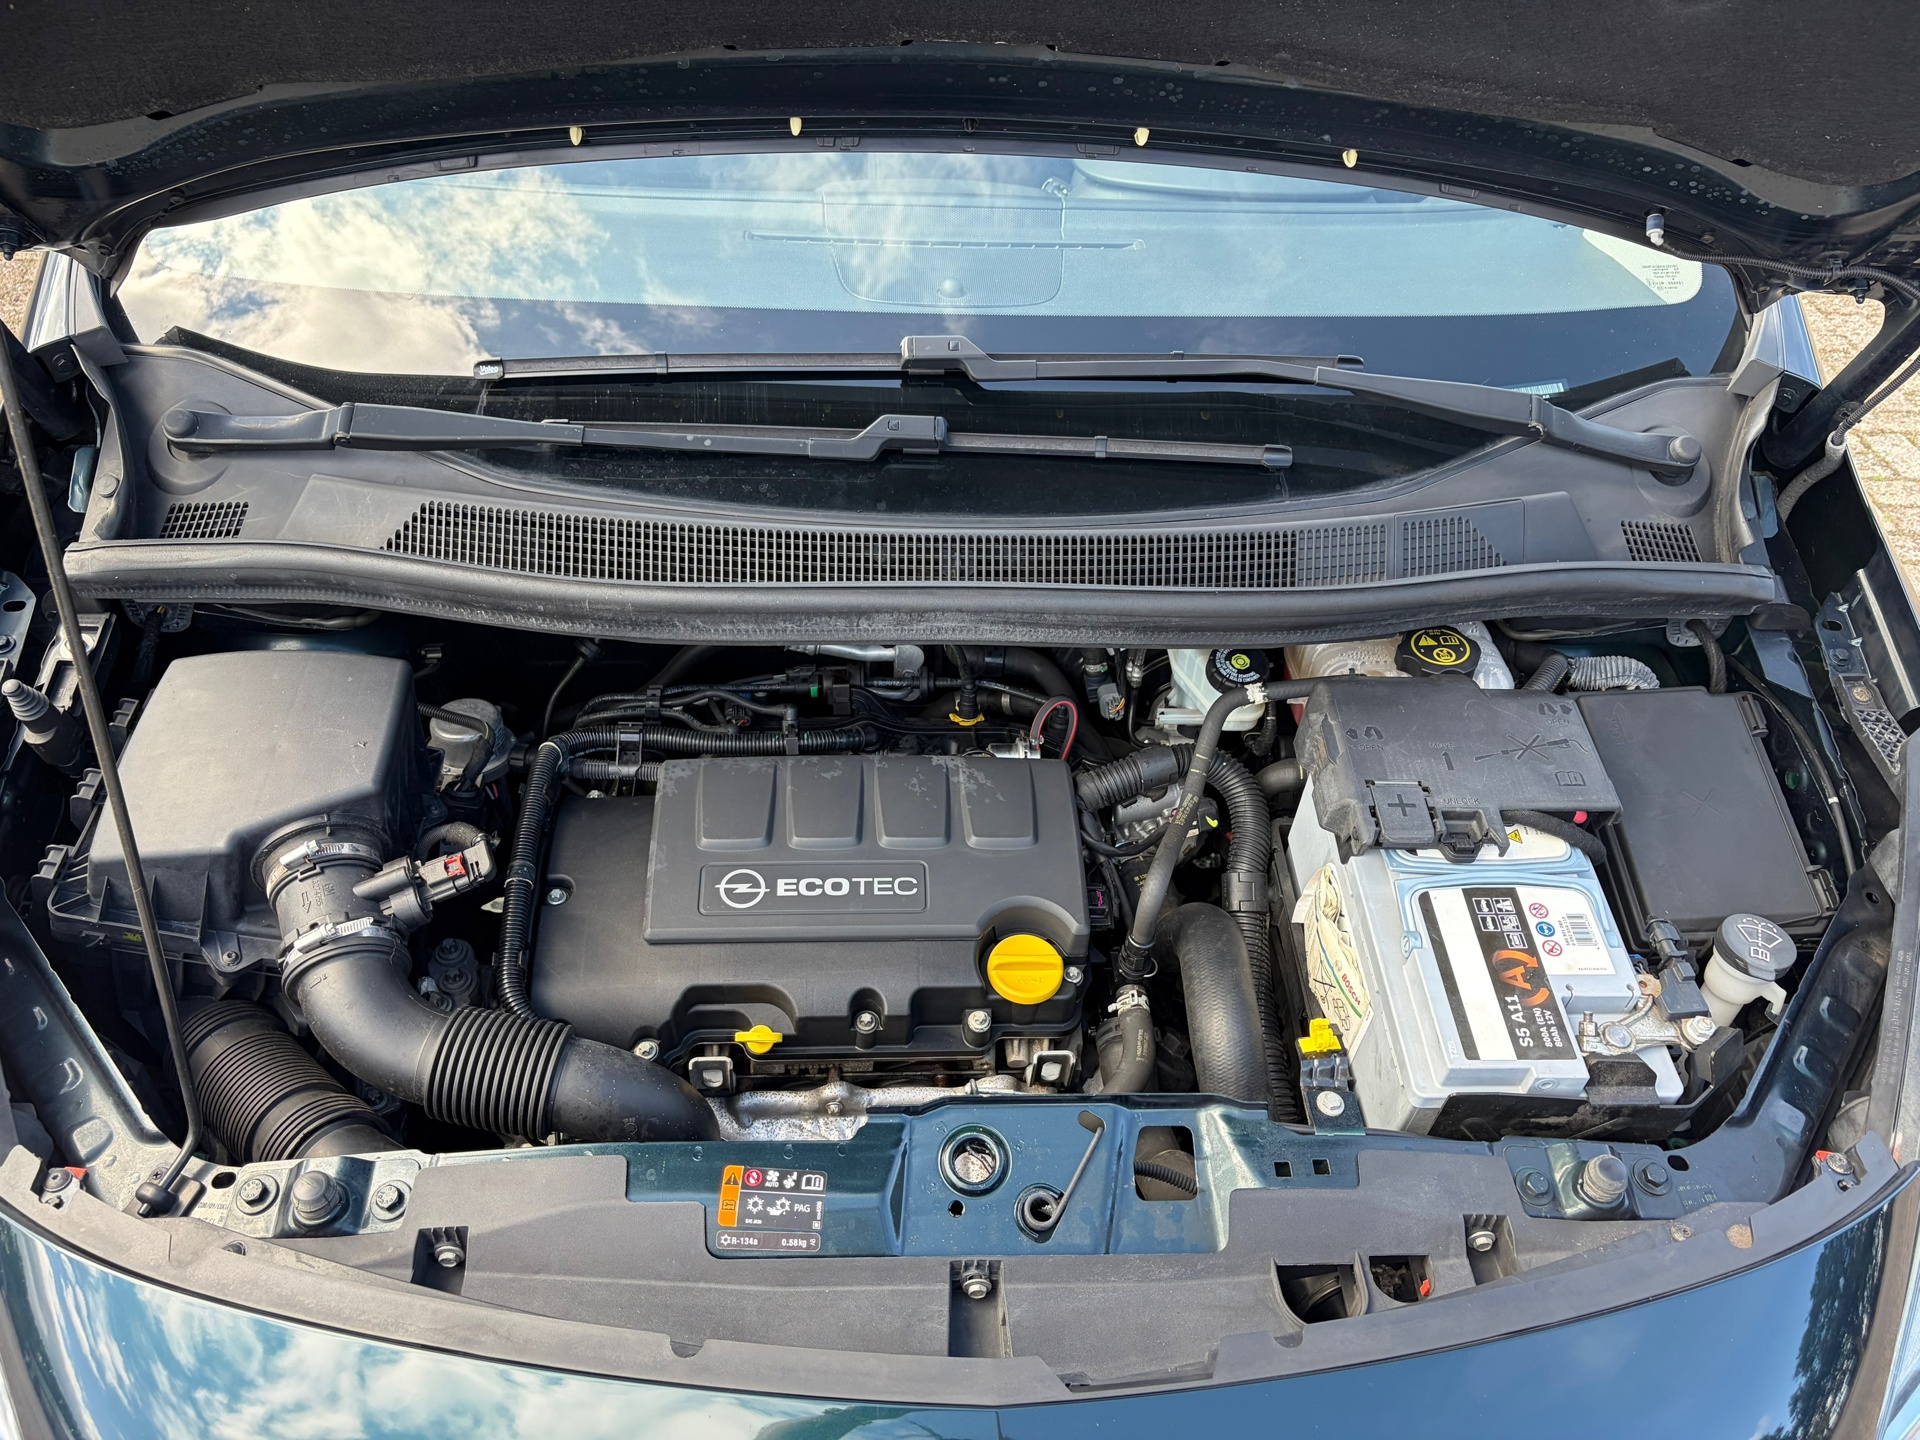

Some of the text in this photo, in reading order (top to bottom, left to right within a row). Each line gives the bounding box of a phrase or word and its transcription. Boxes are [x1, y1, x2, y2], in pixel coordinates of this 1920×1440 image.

[777, 877, 918, 896] ECOTEC
[1504, 994, 1534, 1048] S5 A11
[1532, 1007, 1553, 1047] 800A (EN)
[1542, 1009, 1563, 1047] 80Ah 12V
[794, 1203, 811, 1213] PAG
[731, 1237, 758, 1246] R-134a
